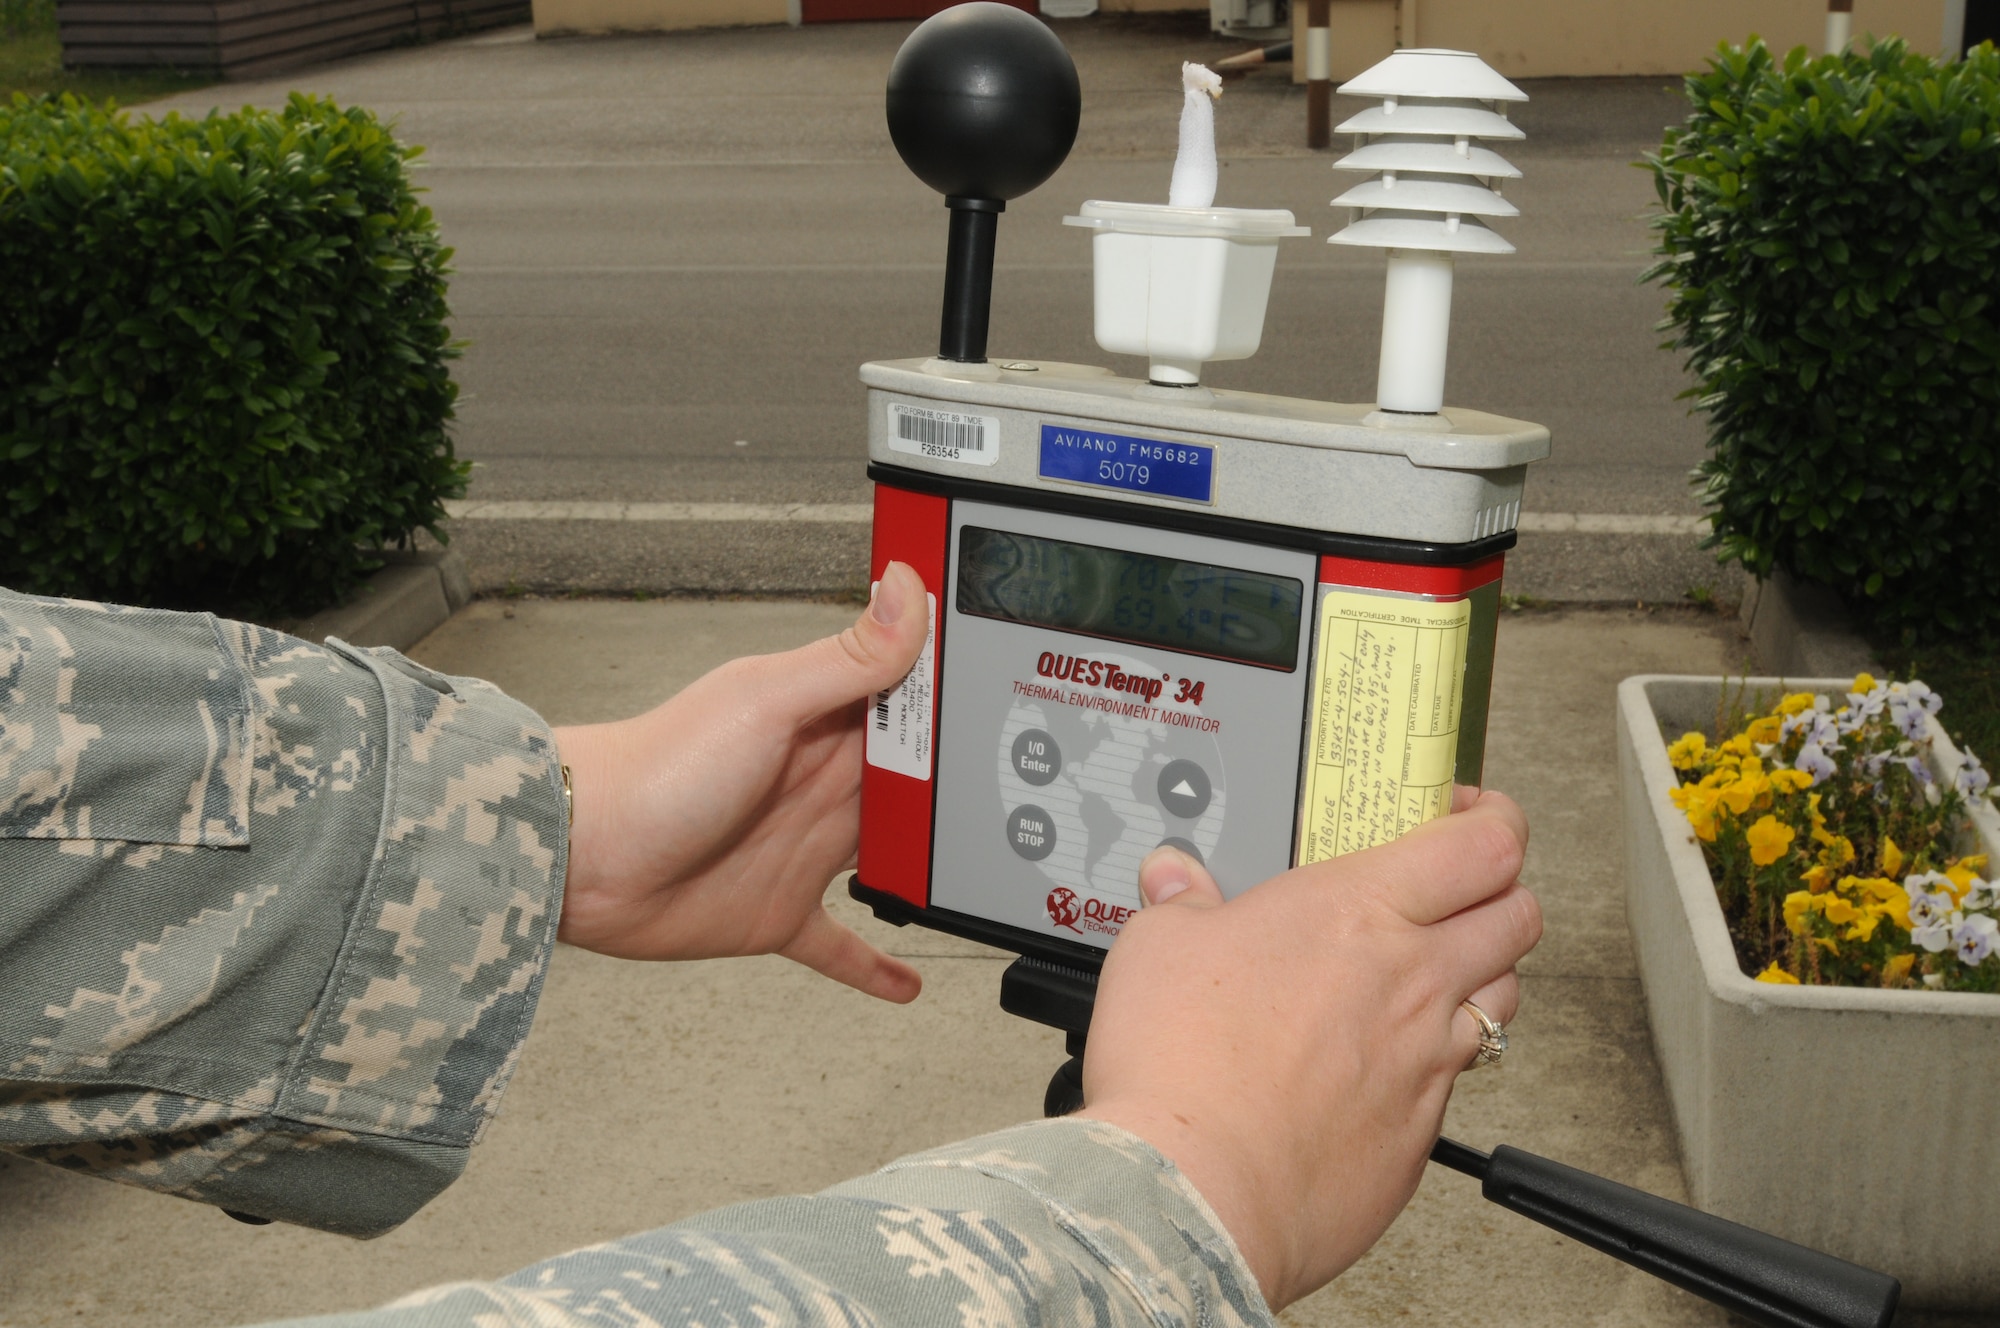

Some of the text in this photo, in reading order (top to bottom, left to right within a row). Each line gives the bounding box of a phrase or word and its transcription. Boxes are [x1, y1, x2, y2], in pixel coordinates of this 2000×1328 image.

[894, 405, 908, 415] AFTO
[909, 408, 926, 418] FORM
[936, 413, 949, 421] OCT
[951, 414, 960, 423] 89
[963, 415, 983, 425] TMDE
[921, 443, 960, 460] F263545
[1054, 433, 1200, 466] AVIANO FM5682
[1099, 460, 1150, 485] 5079
[1340, 608, 1395, 621] CERTIFICATION
[1400, 615, 1421, 624] TMDE
[1174, 677, 1206, 706] 34
[1381, 682, 1389, 693] F
[1409, 663, 1422, 731] DATE CALIBRATED
[916, 684, 924, 725] MEDICAL
[1012, 680, 1220, 734] THERMAL ENVIRONMENT MONITOR
[1432, 712, 1440, 731] DATE
[1028, 740, 1045, 757] I/O
[1319, 717, 1328, 759] AUTHORITY
[1020, 755, 1052, 774] Enter
[1402, 742, 1412, 781] CERTIFIED BY
[1384, 777, 1398, 806] RH
[1019, 818, 1043, 834] RUN
[1017, 831, 1045, 847] STOP
[1309, 832, 1317, 862] NUMBER
[1084, 898, 1138, 924] QUES
[1083, 919, 1120, 936] TECHNO
